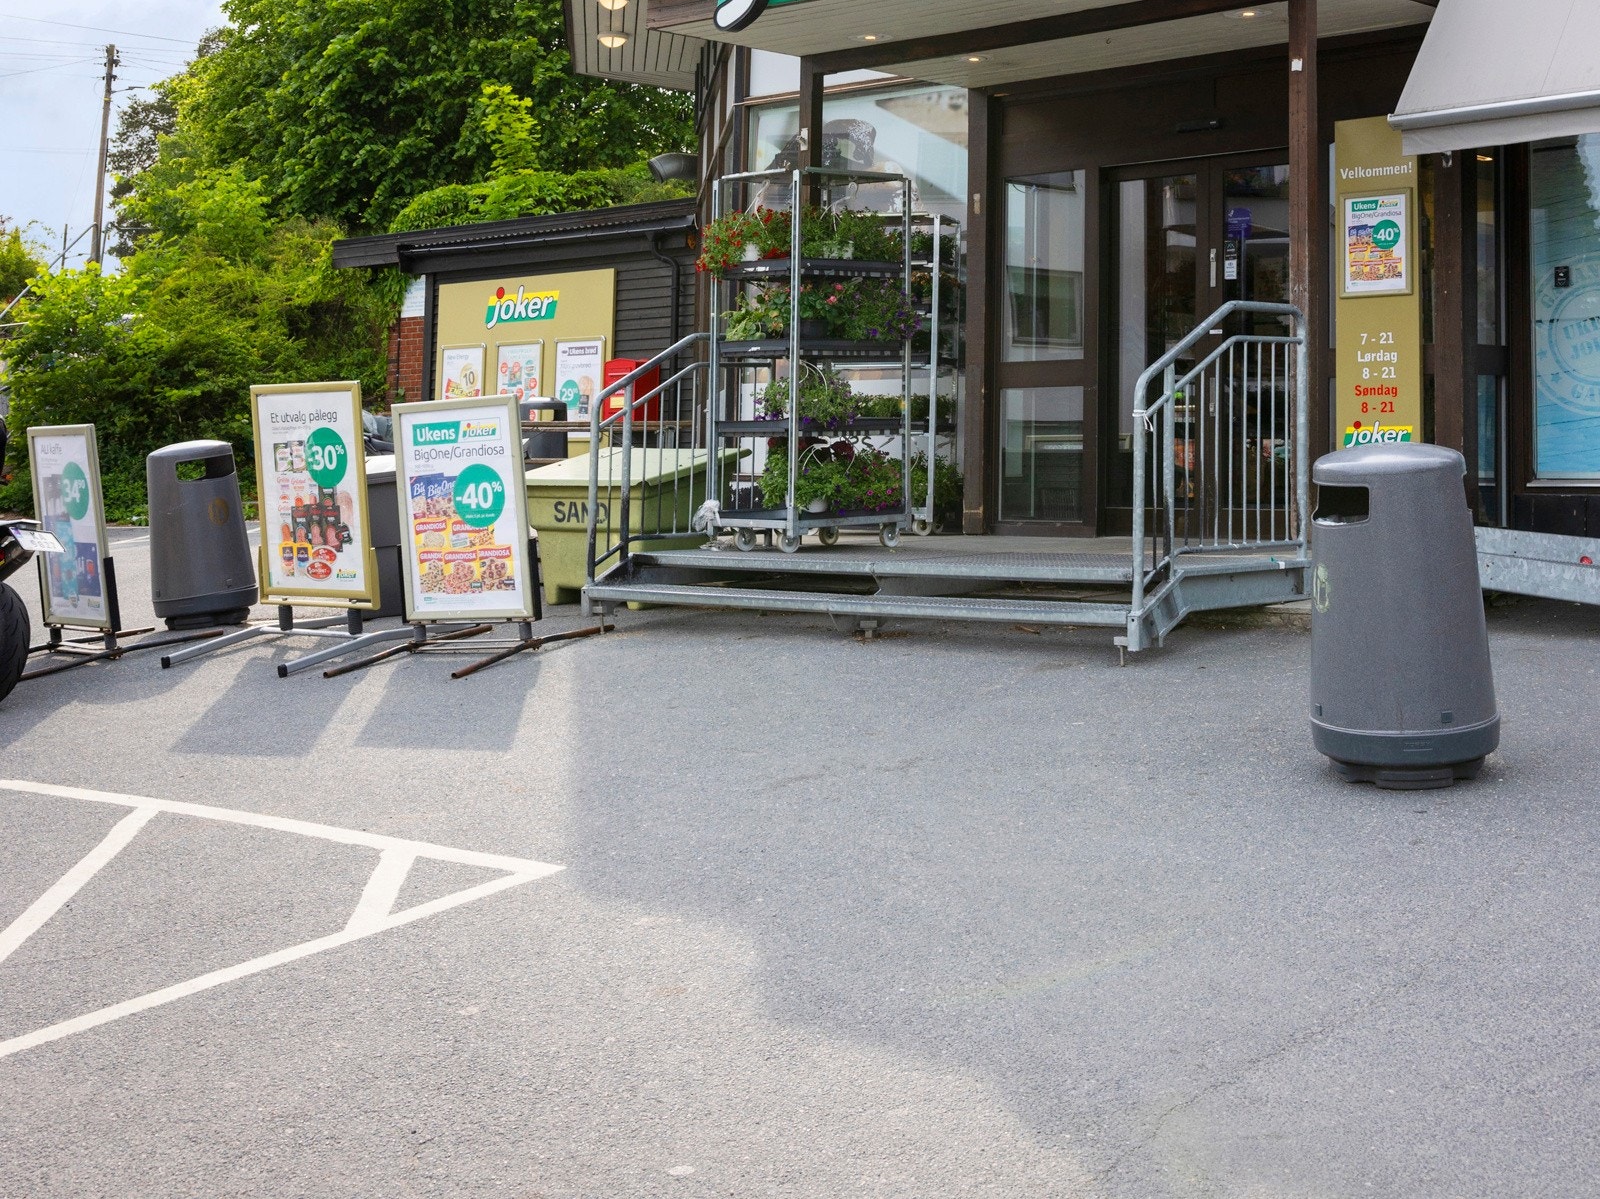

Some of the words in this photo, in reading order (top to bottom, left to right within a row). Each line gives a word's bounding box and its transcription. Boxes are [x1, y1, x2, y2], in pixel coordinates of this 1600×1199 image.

[1340, 161, 1412, 180] Velkommen!
[486, 285, 554, 330] joker
[1360, 333, 1368, 345] 7
[1380, 332, 1394, 344] 21
[1357, 350, 1398, 363] Lørdag
[1362, 367, 1370, 379] 8
[1381, 367, 1396, 379] 21
[1354, 384, 1398, 397] Søndag
[1361, 402, 1368, 413] 8
[1380, 401, 1395, 413] 21
[270, 412, 280, 423] Et
[281, 410, 306, 424] utvalg
[308, 408, 338, 423] pålegg
[416, 426, 456, 442] Ukens
[463, 421, 496, 439] joker
[1345, 420, 1408, 448] joker
[414, 443, 505, 462] BigOne/Grandiosa
[415, 522, 447, 532] GRANDIOSA
[444, 551, 477, 561] GRANDIOSA
